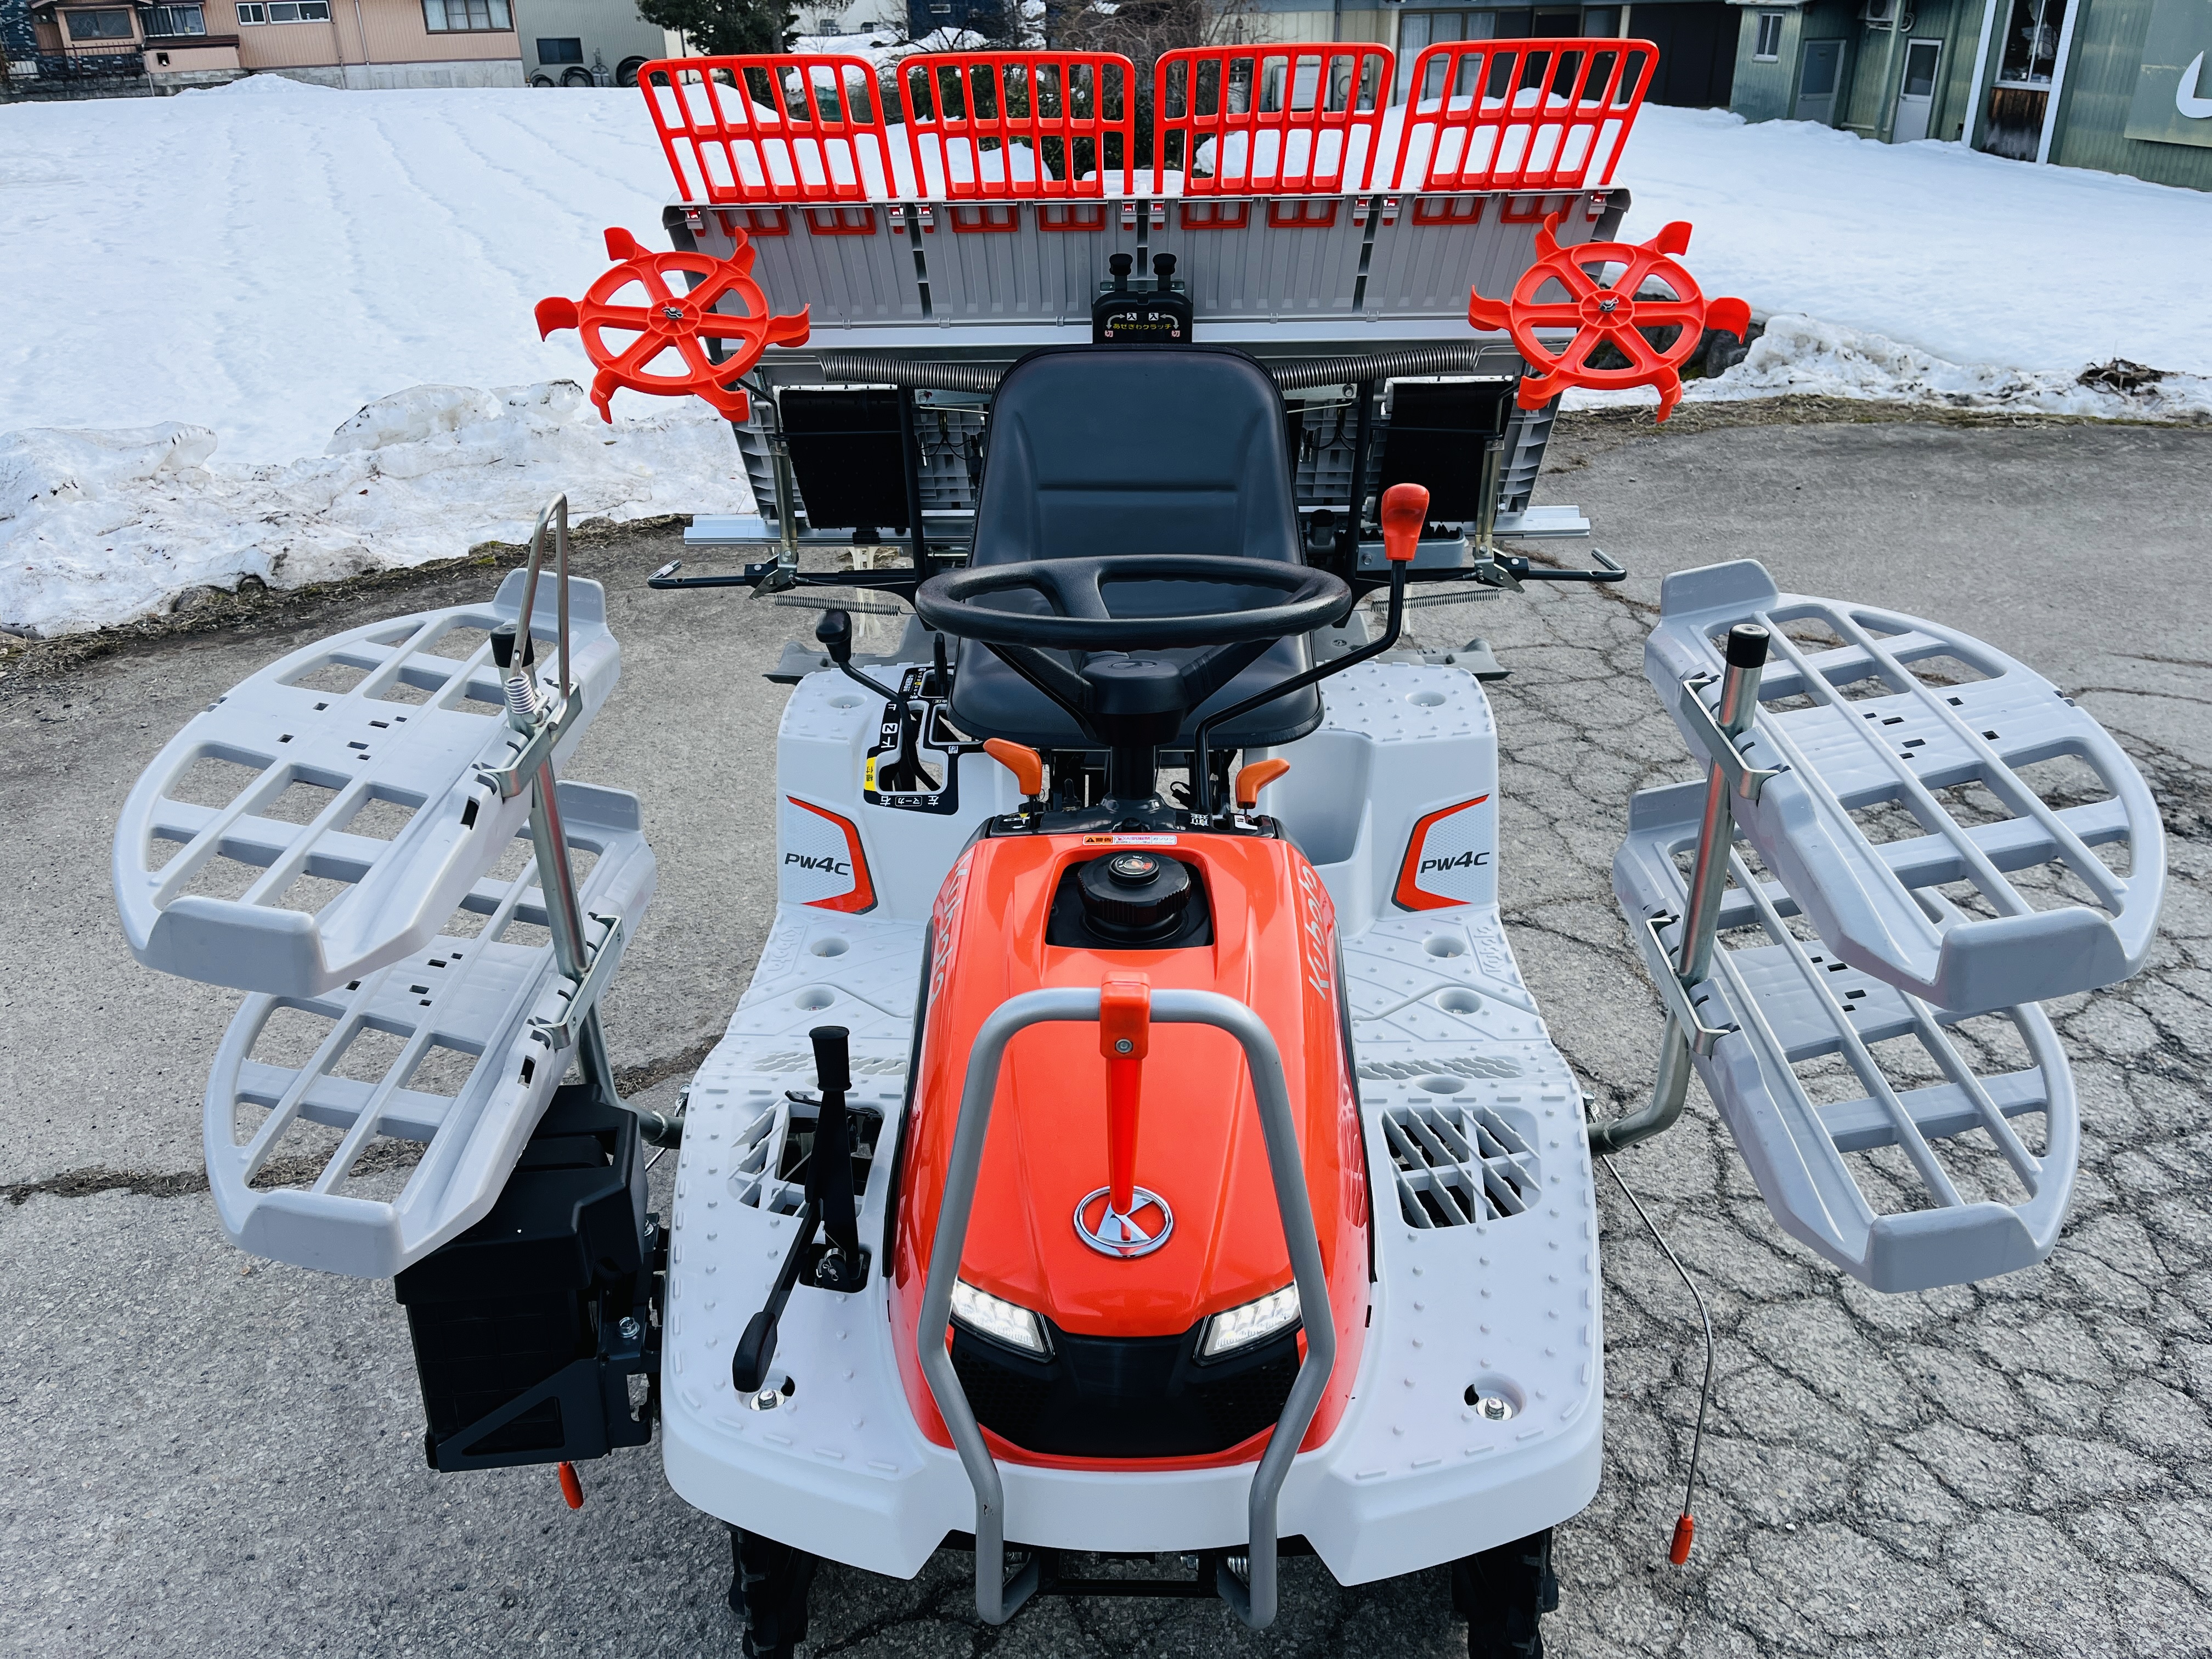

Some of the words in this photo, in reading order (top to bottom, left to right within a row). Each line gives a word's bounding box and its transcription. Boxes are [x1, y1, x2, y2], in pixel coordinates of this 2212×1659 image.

[879, 795, 891, 806] 右
[927, 795, 939, 806] 左
[785, 853, 851, 876] PW4C
[1420, 851, 1490, 873] PW4C
[1298, 865, 1330, 1001] Kubota
[768, 926, 803, 971] Kubota
[1473, 927, 1504, 972] Kubota
